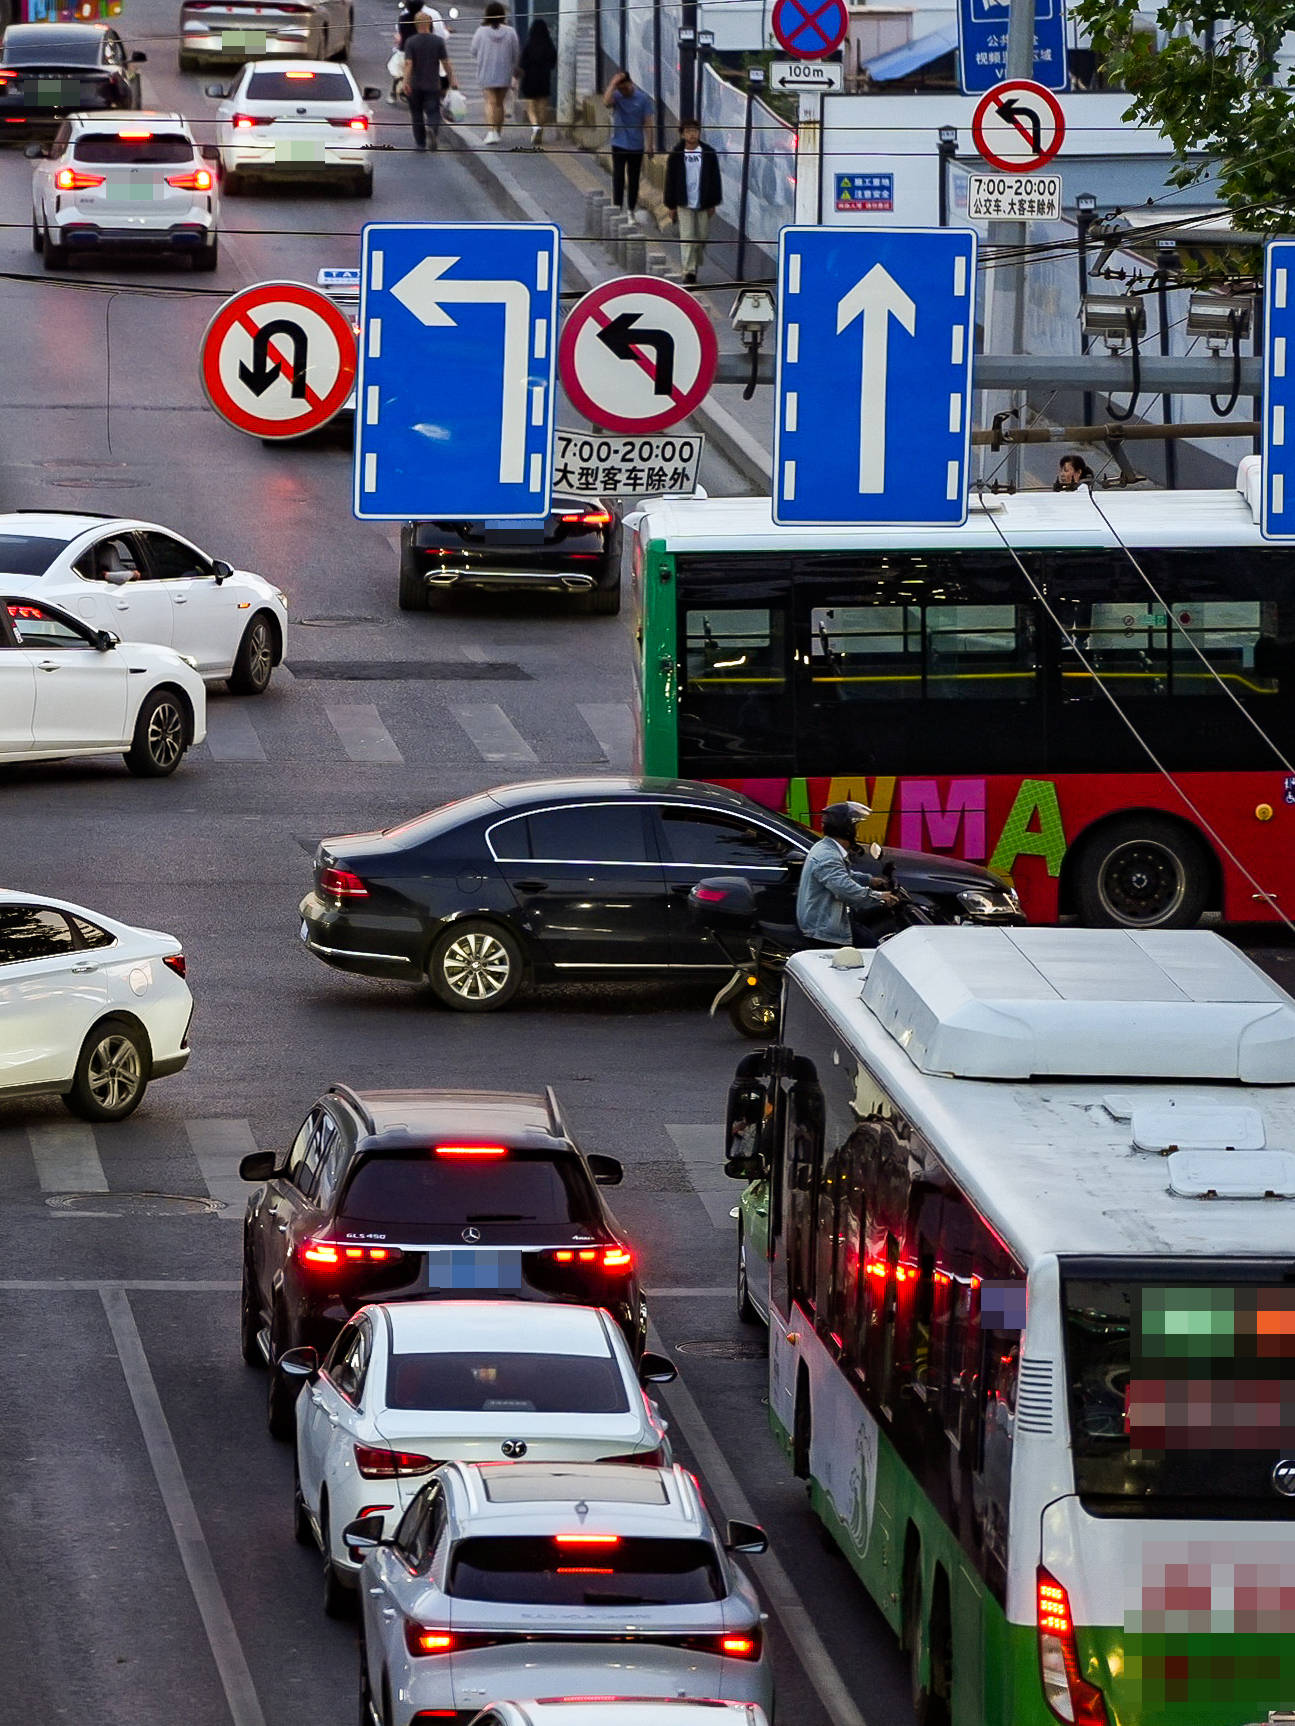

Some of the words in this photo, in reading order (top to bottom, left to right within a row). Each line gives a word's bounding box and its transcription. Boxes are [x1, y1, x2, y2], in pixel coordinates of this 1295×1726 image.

[986, 34, 1039, 47] 公共
[975, 49, 1052, 65] 视频域
[789, 66, 824, 77] 100m
[974, 179, 1057, 196] 7:00-20:00
[974, 198, 1056, 216] 公交车、大客车除外
[557, 436, 694, 463] 7:00-20:00
[553, 462, 691, 492] 大型客车除外
